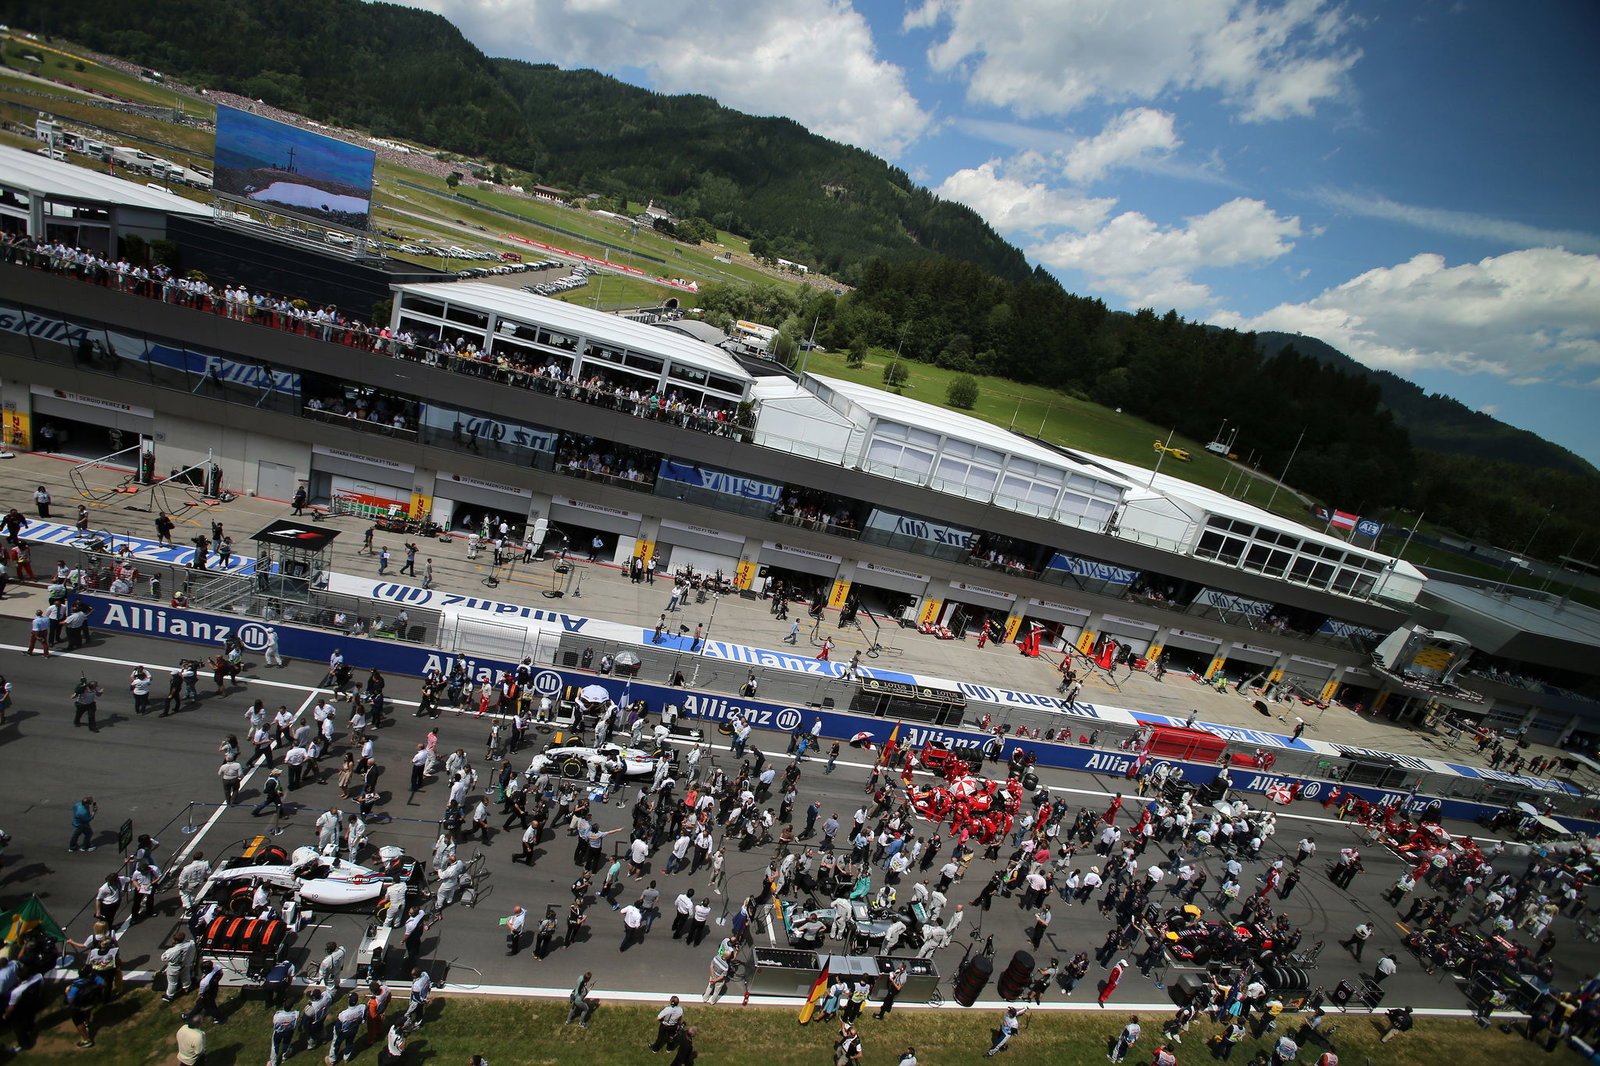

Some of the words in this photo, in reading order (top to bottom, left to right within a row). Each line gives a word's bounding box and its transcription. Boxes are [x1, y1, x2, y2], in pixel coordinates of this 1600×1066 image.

[79, 395, 101, 405] SERGIO
[101, 400, 121, 409] PEREZ
[329, 448, 349, 457] SAHARA
[349, 452, 365, 461] FORCE
[470, 478, 485, 486] KEVIN
[485, 481, 514, 492] MAGNUSSEN
[586, 503, 603, 511] JENSON
[603, 506, 621, 515] BUTTON
[790, 547, 805, 555] ROMAIN
[104, 603, 230, 642] Allianz
[702, 639, 828, 675] Allianz
[883, 681, 907, 690] LOTUS
[935, 690, 959, 698] LOTUS
